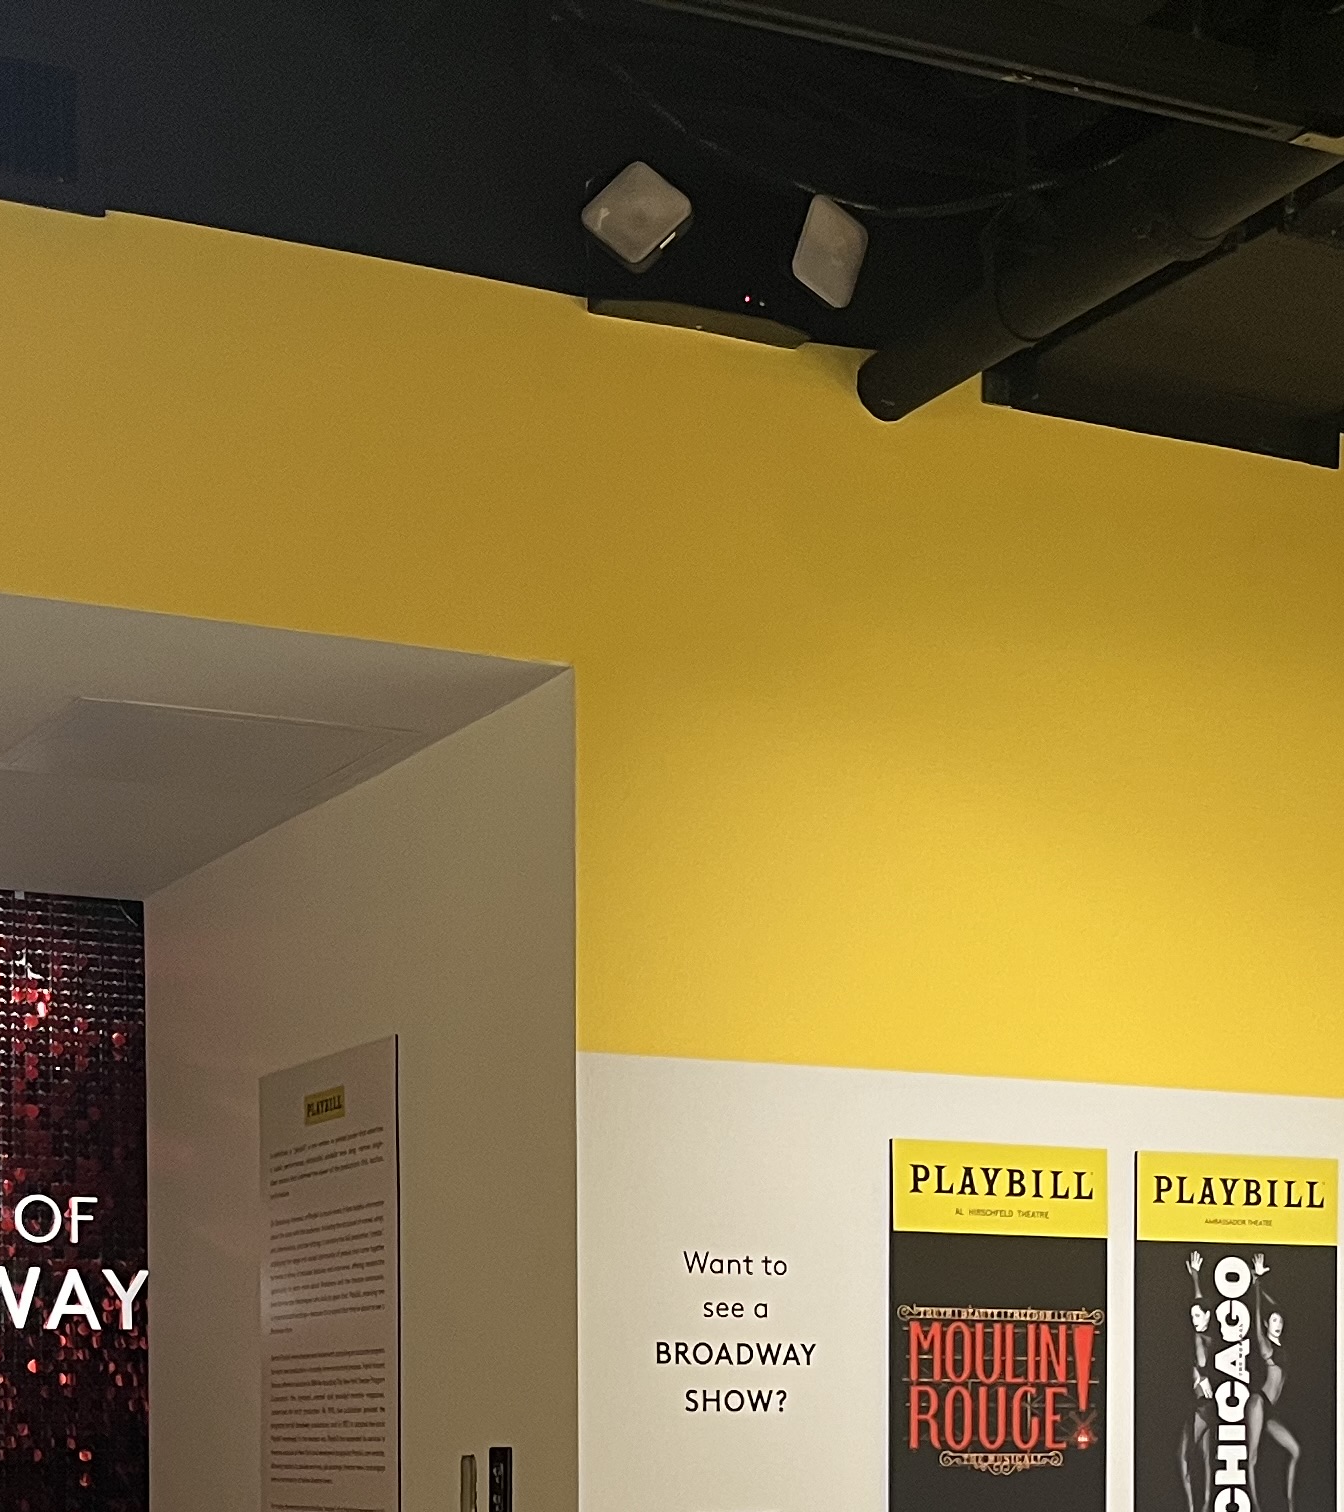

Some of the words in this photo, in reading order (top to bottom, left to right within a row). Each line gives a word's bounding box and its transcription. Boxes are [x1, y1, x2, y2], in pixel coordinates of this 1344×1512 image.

[909, 1163, 1093, 1200] PLAYBILL
[1153, 1175, 1325, 1209] PLAYBILL
[14, 1195, 98, 1244] OF
[955, 1207, 964, 1216] AL
[1018, 1210, 1049, 1220] THEATRE
[683, 1250, 754, 1275] Want
[761, 1256, 787, 1276] to
[703, 1301, 744, 1318] see
[754, 1302, 768, 1318] a
[656, 1341, 816, 1366] BROADWAY
[685, 1389, 787, 1412] SHOW?
